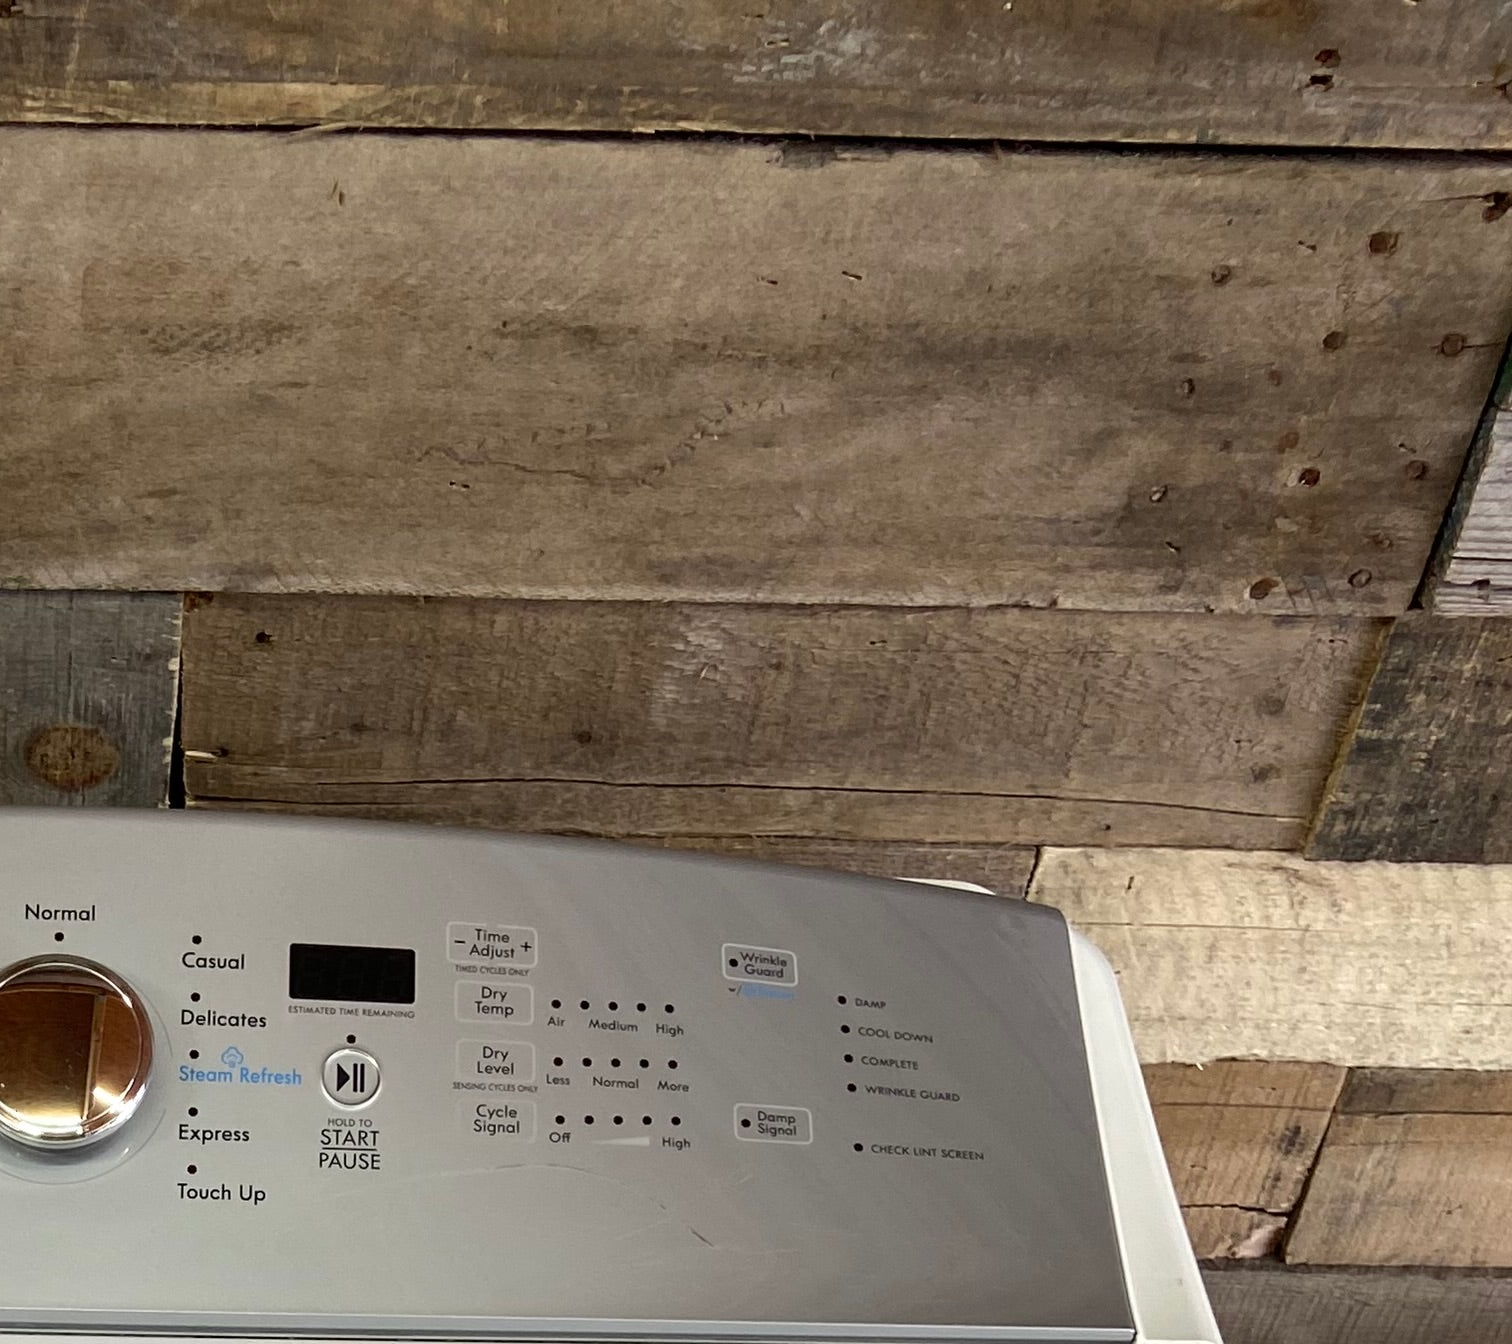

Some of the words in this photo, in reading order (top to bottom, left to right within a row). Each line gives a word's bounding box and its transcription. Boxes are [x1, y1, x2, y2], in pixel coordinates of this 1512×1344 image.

[25, 903, 96, 922] Normal
[475, 928, 510, 944] Time
[181, 951, 245, 970] Casual
[469, 944, 515, 960] Adjust
[739, 951, 787, 967] Wrinkle
[744, 963, 784, 979] Guard
[481, 986, 508, 1002] Dry
[474, 1001, 514, 1019] Temp
[855, 997, 886, 1010] DAMP
[180, 1009, 267, 1028] Delicates
[288, 1005, 336, 1016] ESTIMATED
[339, 1008, 359, 1017] TIME
[362, 1009, 415, 1020] REMAINING
[547, 1016, 565, 1028] Air
[588, 1018, 638, 1033] Medium
[656, 1024, 684, 1039] High
[857, 1026, 890, 1039] COOL
[894, 1030, 933, 1043] DOWN
[482, 1046, 509, 1062] Dry
[860, 1055, 919, 1070] COMPLETE
[178, 1065, 233, 1084] Steam
[239, 1067, 302, 1086] Refresh
[477, 1061, 514, 1076] Level
[546, 1074, 570, 1086] Less
[592, 1076, 639, 1090] Normal
[657, 1080, 689, 1093] More
[864, 1085, 917, 1099] WRINKLE
[920, 1089, 960, 1102] GUARD
[476, 1103, 518, 1121] Cycle
[757, 1110, 797, 1126] Damp
[327, 1118, 355, 1128] HOLD
[358, 1119, 373, 1128] TO
[473, 1119, 520, 1136] Signal
[757, 1122, 797, 1138] Signal
[178, 1124, 250, 1145] Express
[320, 1129, 379, 1147] START
[549, 1131, 571, 1144] Off
[662, 1137, 691, 1151] High
[870, 1143, 910, 1157] CHECK
[913, 1146, 937, 1158] LINT
[941, 1148, 984, 1162] SCREEN
[319, 1153, 380, 1170] PAUSE
[177, 1183, 231, 1201] Touch
[239, 1185, 266, 1205] Up
